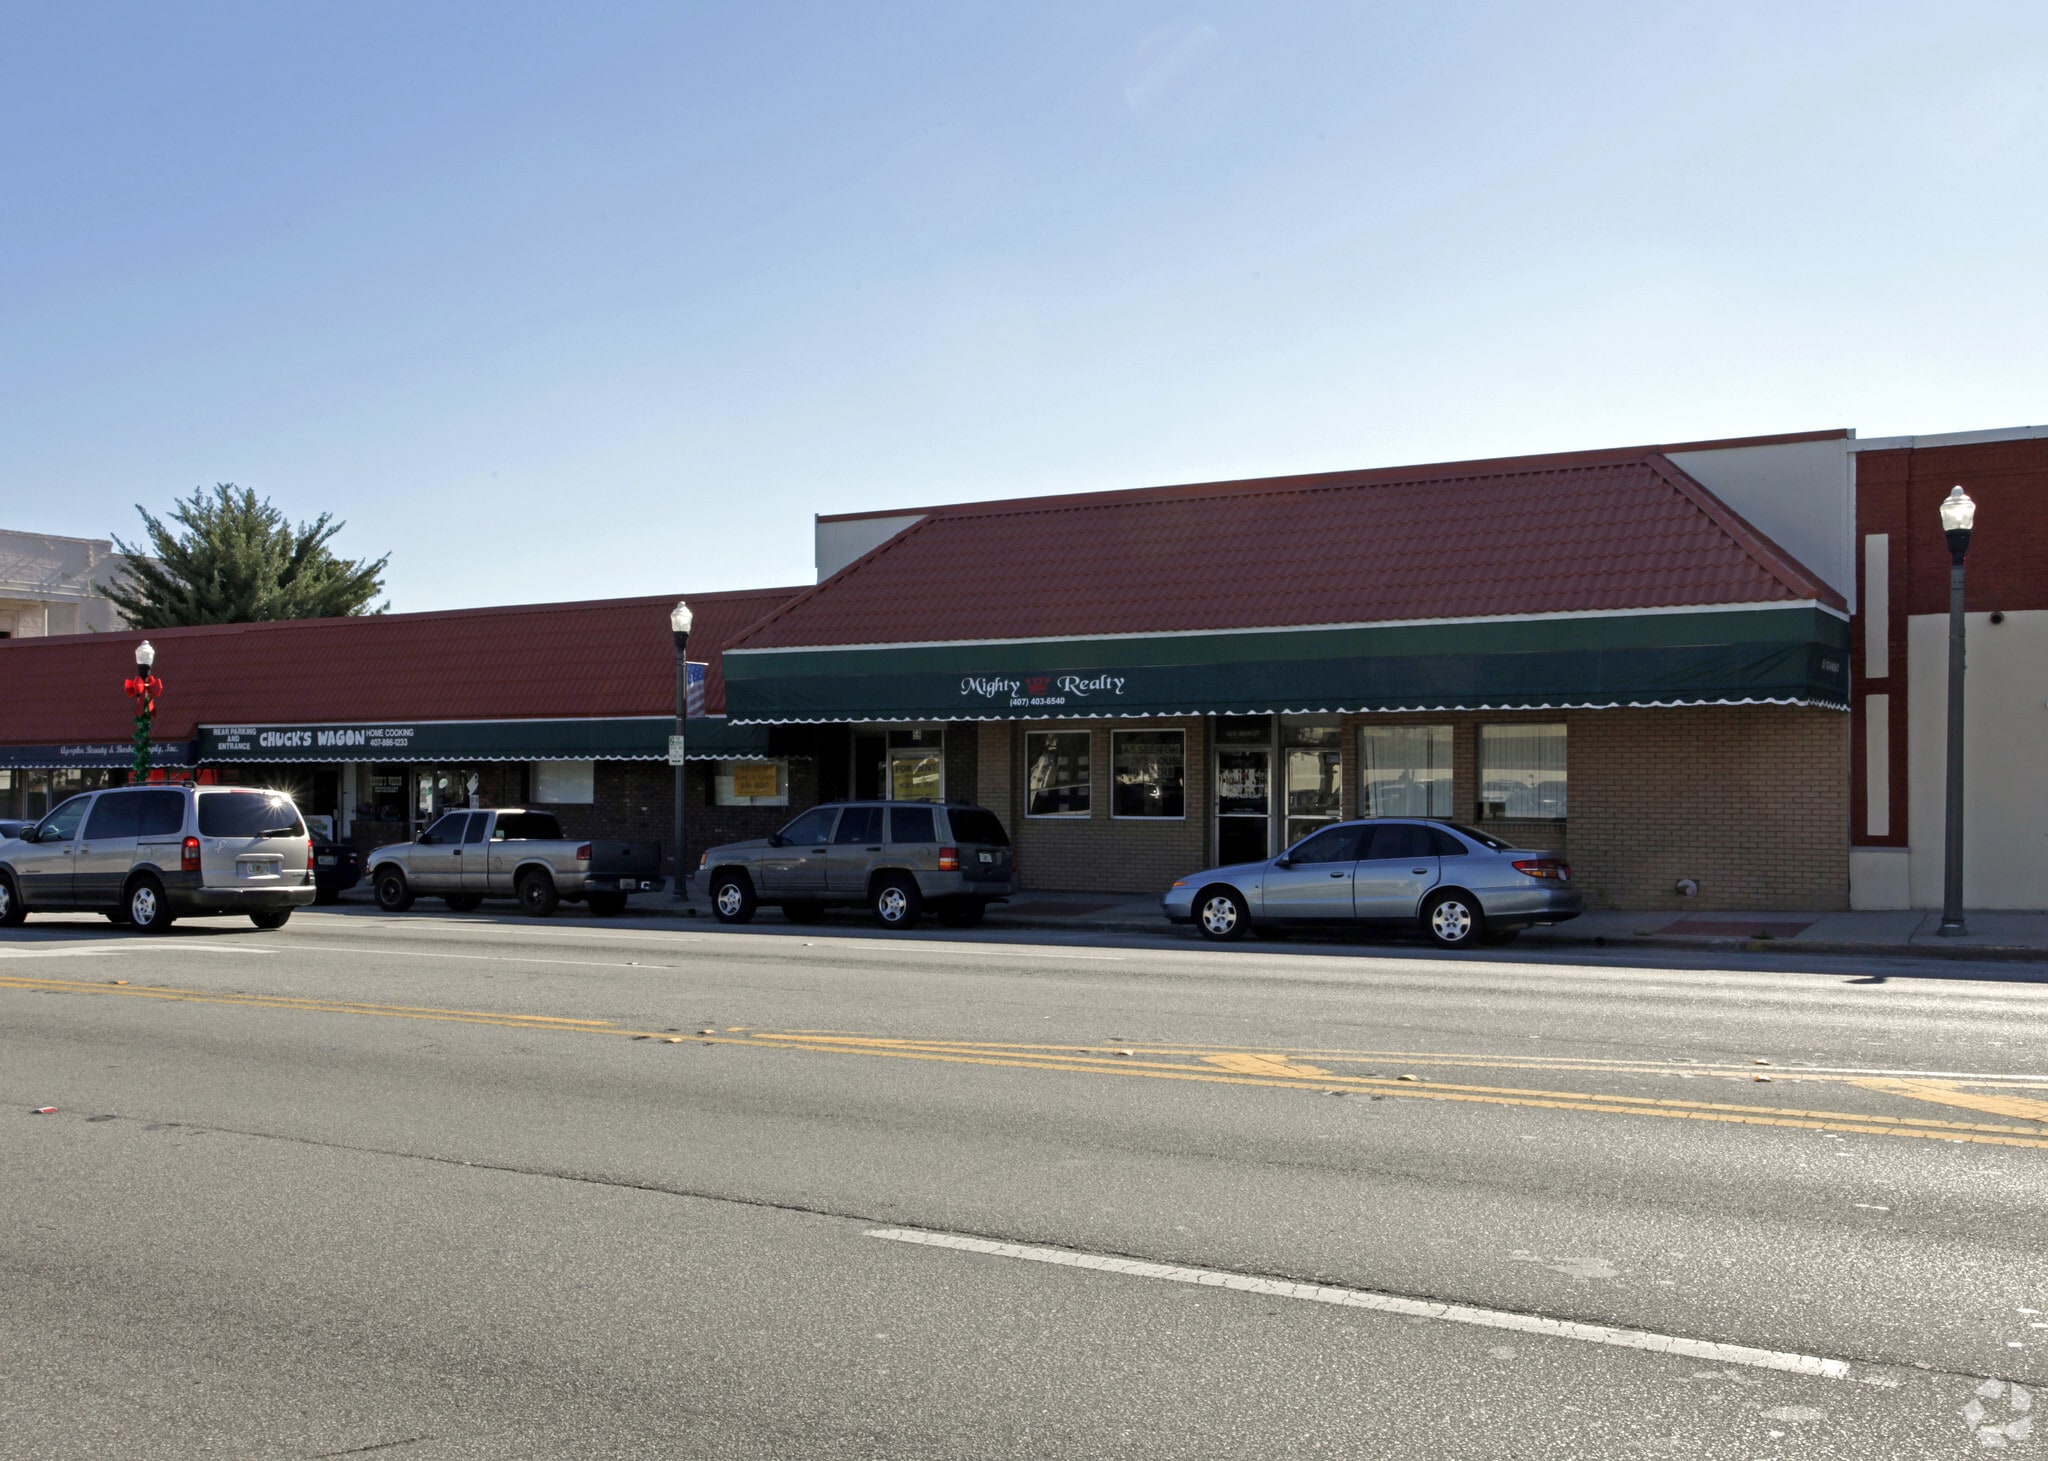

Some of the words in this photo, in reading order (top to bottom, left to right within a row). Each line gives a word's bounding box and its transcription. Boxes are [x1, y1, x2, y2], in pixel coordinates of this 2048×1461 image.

[961, 676, 1020, 697] Mighty
[1057, 675, 1125, 696] Realty
[1010, 698, 1029, 707] (407)
[1030, 697, 1066, 705] 403-6540
[230, 728, 257, 736] PARKING
[366, 729, 384, 737] HOME
[384, 728, 414, 736] COOKING
[260, 731, 312, 747] CHUCK'S
[317, 729, 365, 746] WAGON
[86, 745, 107, 755] Beauty
[218, 742, 251, 750] ENTRANCE
